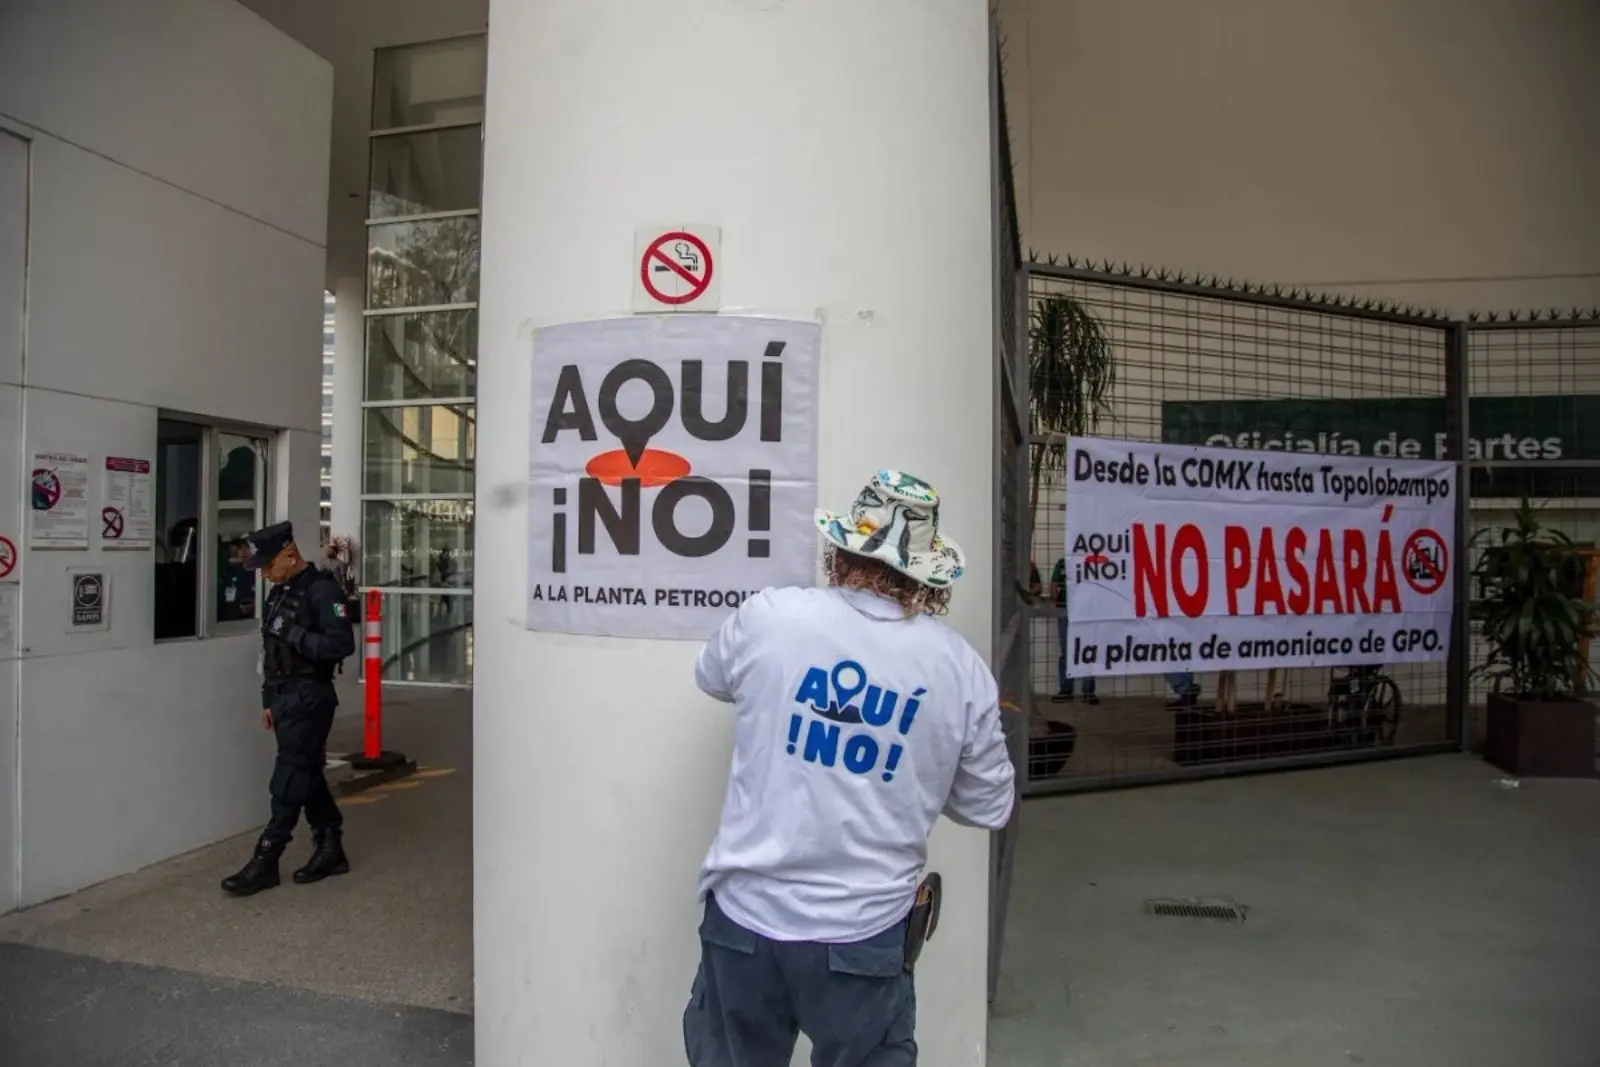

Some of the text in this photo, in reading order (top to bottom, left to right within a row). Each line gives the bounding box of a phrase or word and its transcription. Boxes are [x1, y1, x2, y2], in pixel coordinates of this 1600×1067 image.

[541, 341, 786, 470] AQUÍ
[1373, 431, 1422, 458] de
[1074, 449, 1449, 504] Desde la CDMX hasta Topolobampo
[552, 469, 771, 573] ¡NO!
[1073, 529, 1130, 556] AQUÍ
[1076, 560, 1127, 584] ¡NO!
[1132, 504, 1402, 618] NO PASARÁ
[533, 584, 543, 600] A
[548, 585, 567, 602] LA
[574, 586, 647, 606] PLANTA
[1074, 629, 1443, 670] la planta de amoniaco de GPO.
[795, 660, 927, 735] AQUÍ
